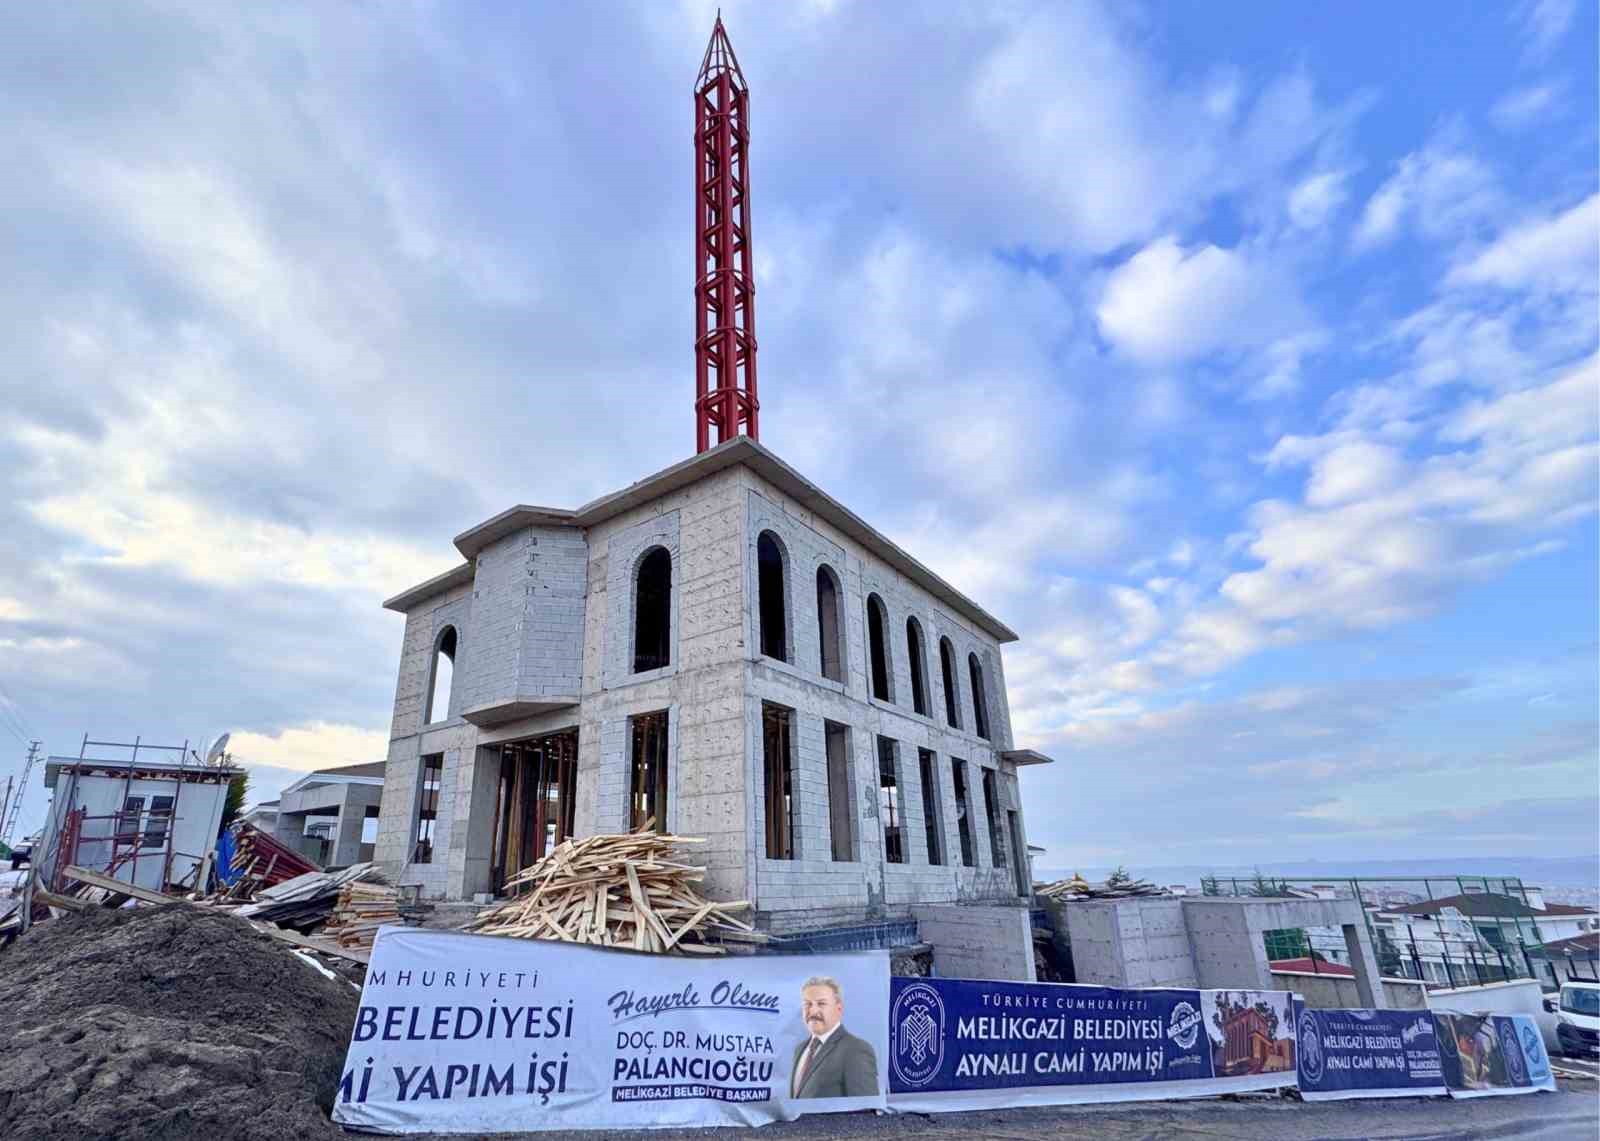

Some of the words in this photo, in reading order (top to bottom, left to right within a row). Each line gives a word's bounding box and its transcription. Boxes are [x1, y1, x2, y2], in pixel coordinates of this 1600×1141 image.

[369, 968, 539, 988] MHURİYETİ
[607, 982, 700, 1018] Hayırlı
[710, 980, 779, 1009] Olsun
[982, 994, 1048, 1008] TÜRKİYE
[1056, 998, 1148, 1011] CUMHURİYETİ
[353, 998, 574, 1042] BELEDİYESİ
[956, 1012, 1065, 1039] MELİKGAZİ
[1073, 1015, 1163, 1039] BELEDİYESİ
[616, 1031, 657, 1054] DOÇ.
[663, 1031, 690, 1049] DR.
[695, 1033, 774, 1054] MUSTAFA
[613, 1056, 774, 1082] PALANCIOĞLU
[955, 1052, 1028, 1077] AYNALI
[1034, 1047, 1085, 1073] CAMİ
[1091, 1051, 1142, 1072] YAPIM
[1145, 1046, 1164, 1076] İŞİ
[393, 1062, 515, 1102] YAPIM
[526, 1051, 569, 1106] İŞİ
[615, 1086, 672, 1100] MELİKGAZİ
[674, 1085, 724, 1098] BELEDİYE
[726, 1089, 768, 1101] BAŞKANI
